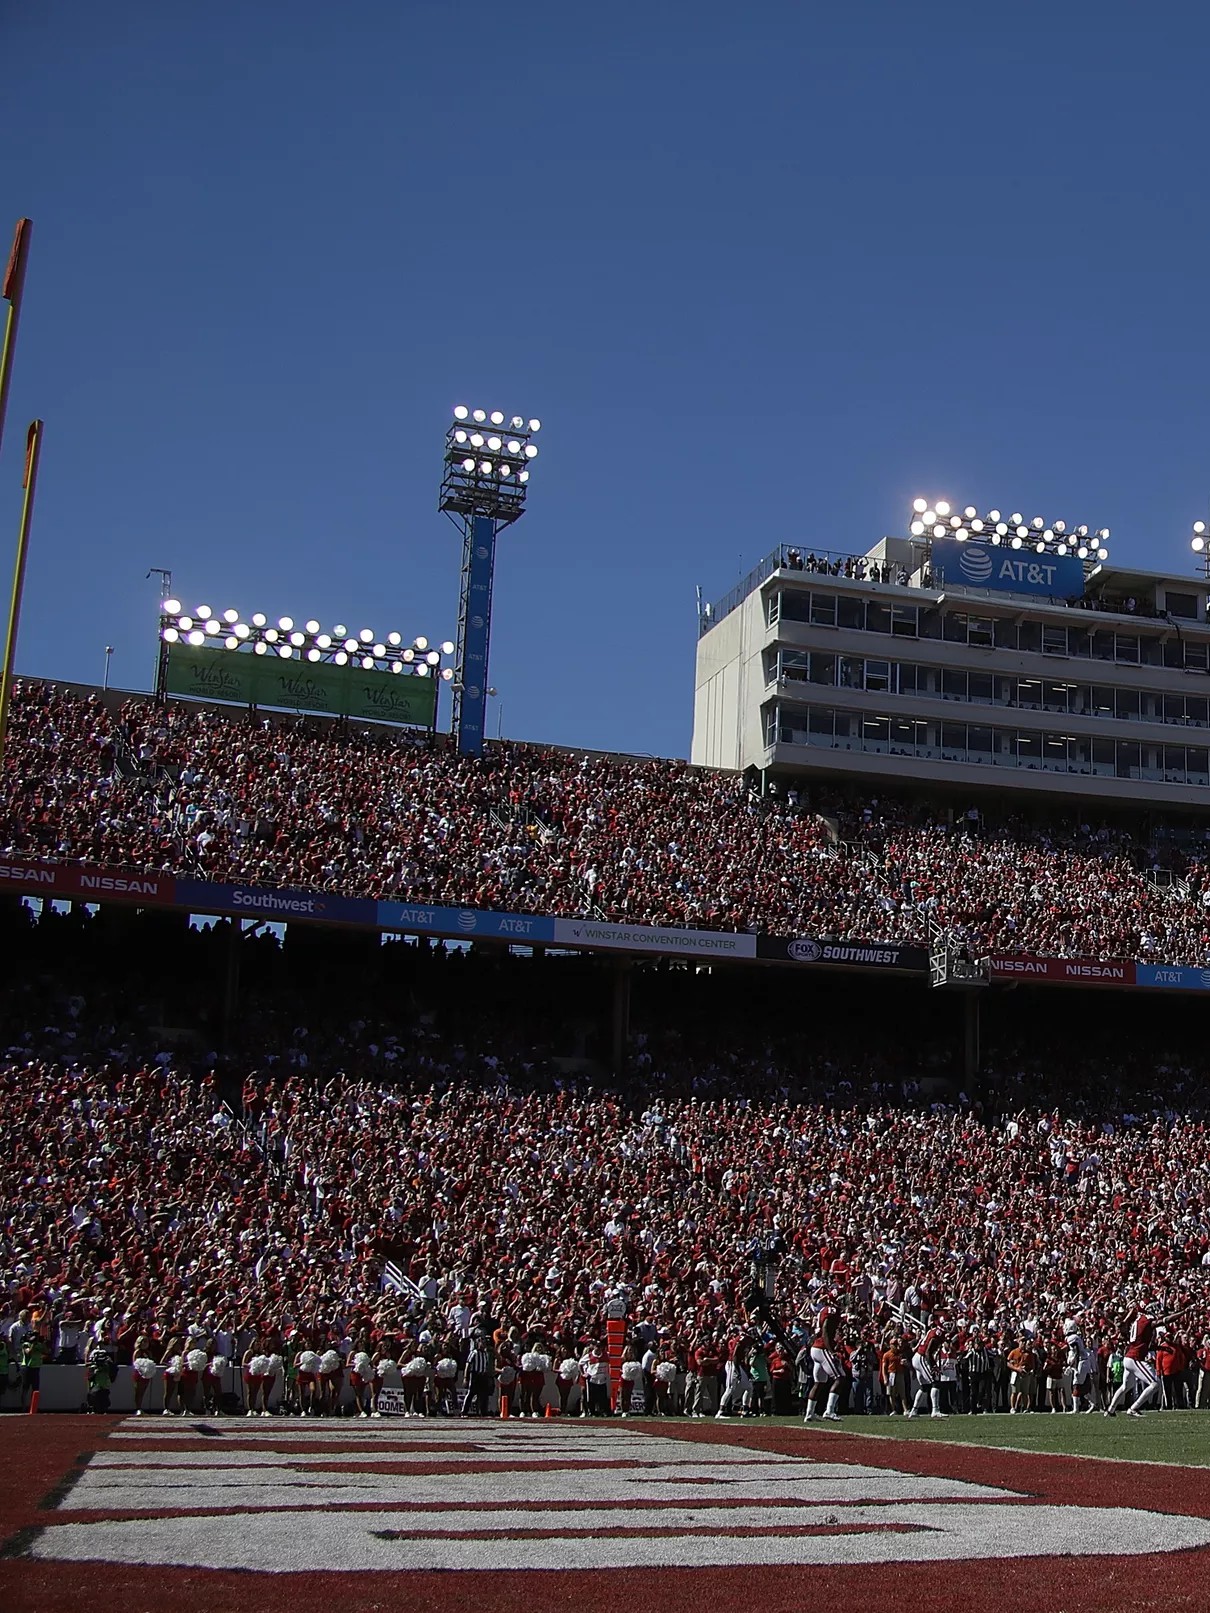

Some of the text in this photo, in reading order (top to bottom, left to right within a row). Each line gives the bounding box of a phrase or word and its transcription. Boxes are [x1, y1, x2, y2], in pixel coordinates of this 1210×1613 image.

[999, 560, 1056, 585] AT&T
[191, 659, 240, 689] WinStar
[278, 671, 326, 700] WinStar
[364, 684, 410, 711] WinStar
[80, 875, 158, 894] NISSAN
[232, 891, 314, 912] Southwest
[400, 910, 435, 924] AT&T
[498, 919, 533, 933] AT&T
[585, 929, 736, 950] WINSTAR CONVENTION CENTER
[796, 944, 814, 954] FOX
[823, 946, 900, 964] SOUTHWEST
[991, 960, 1047, 973] NISSAN
[1066, 964, 1124, 978] NISSAN
[1154, 971, 1182, 982] AT&T
[379, 1400, 404, 1412] OOME
